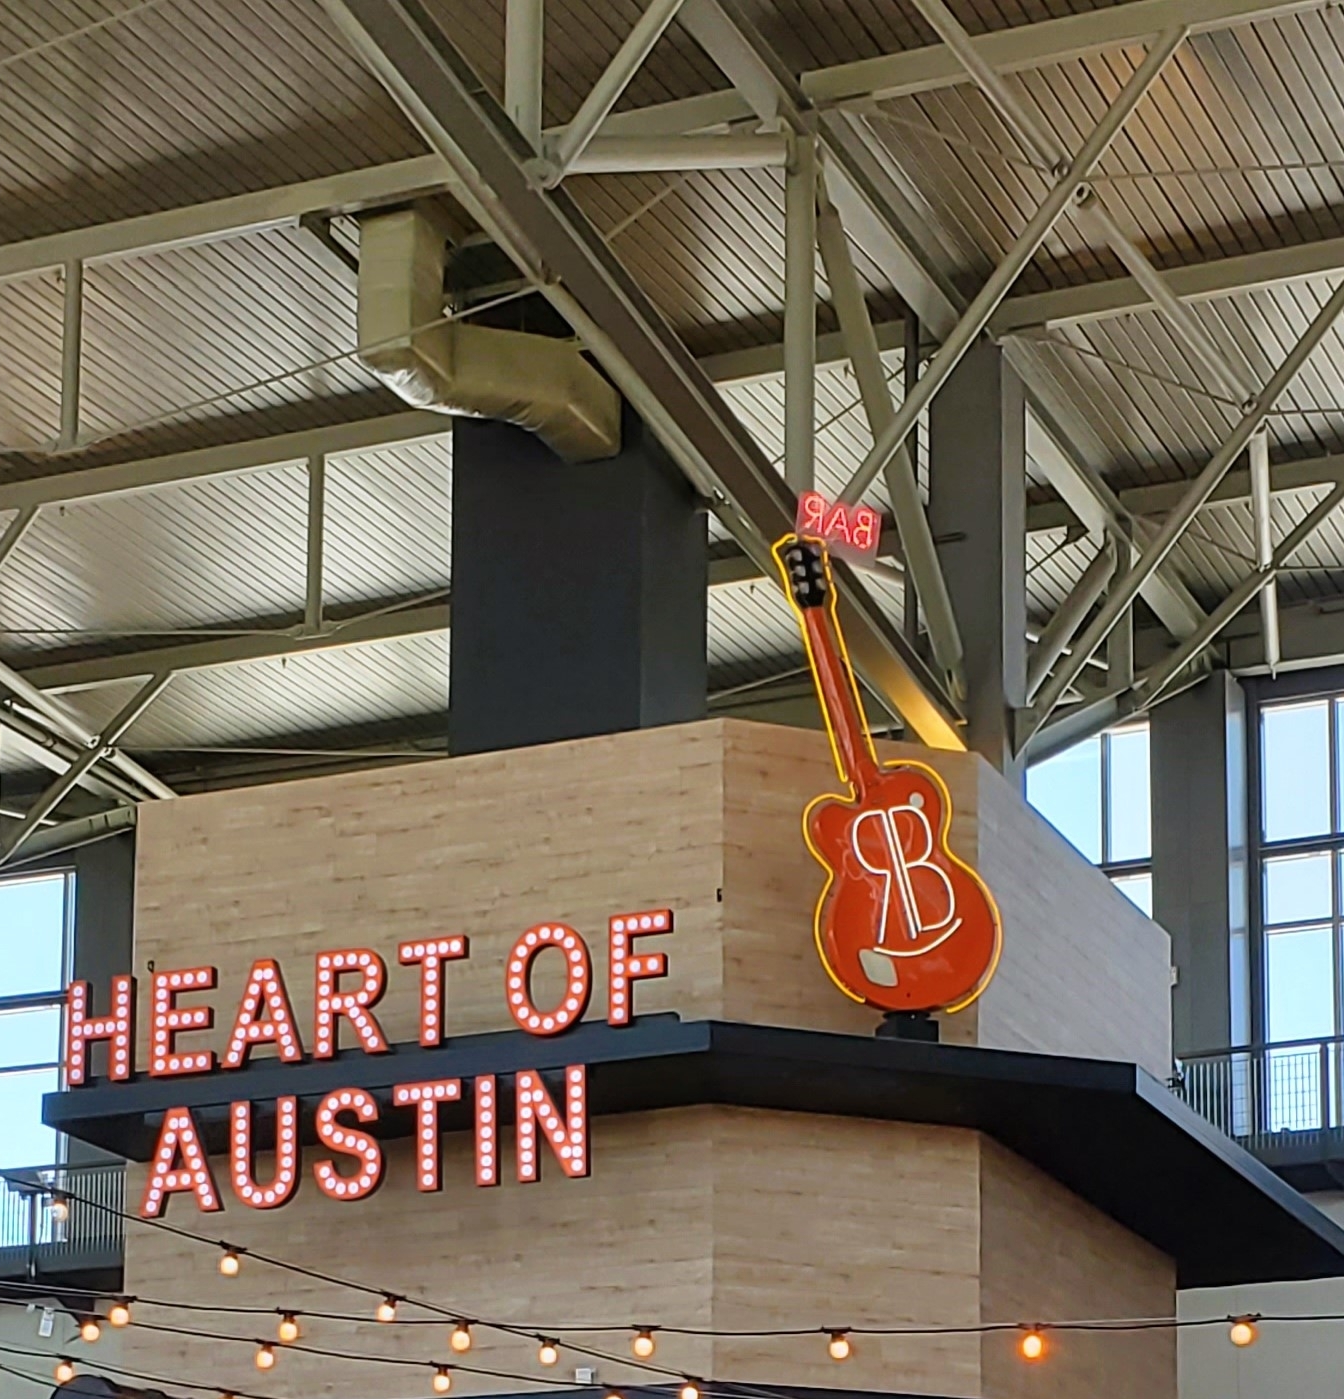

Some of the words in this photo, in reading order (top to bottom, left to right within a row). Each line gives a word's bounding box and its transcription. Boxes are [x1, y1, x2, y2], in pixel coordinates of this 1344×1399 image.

[63, 935, 469, 1085] HEART
[505, 908, 673, 1037] OF
[140, 1063, 589, 1217] AUSTIN
